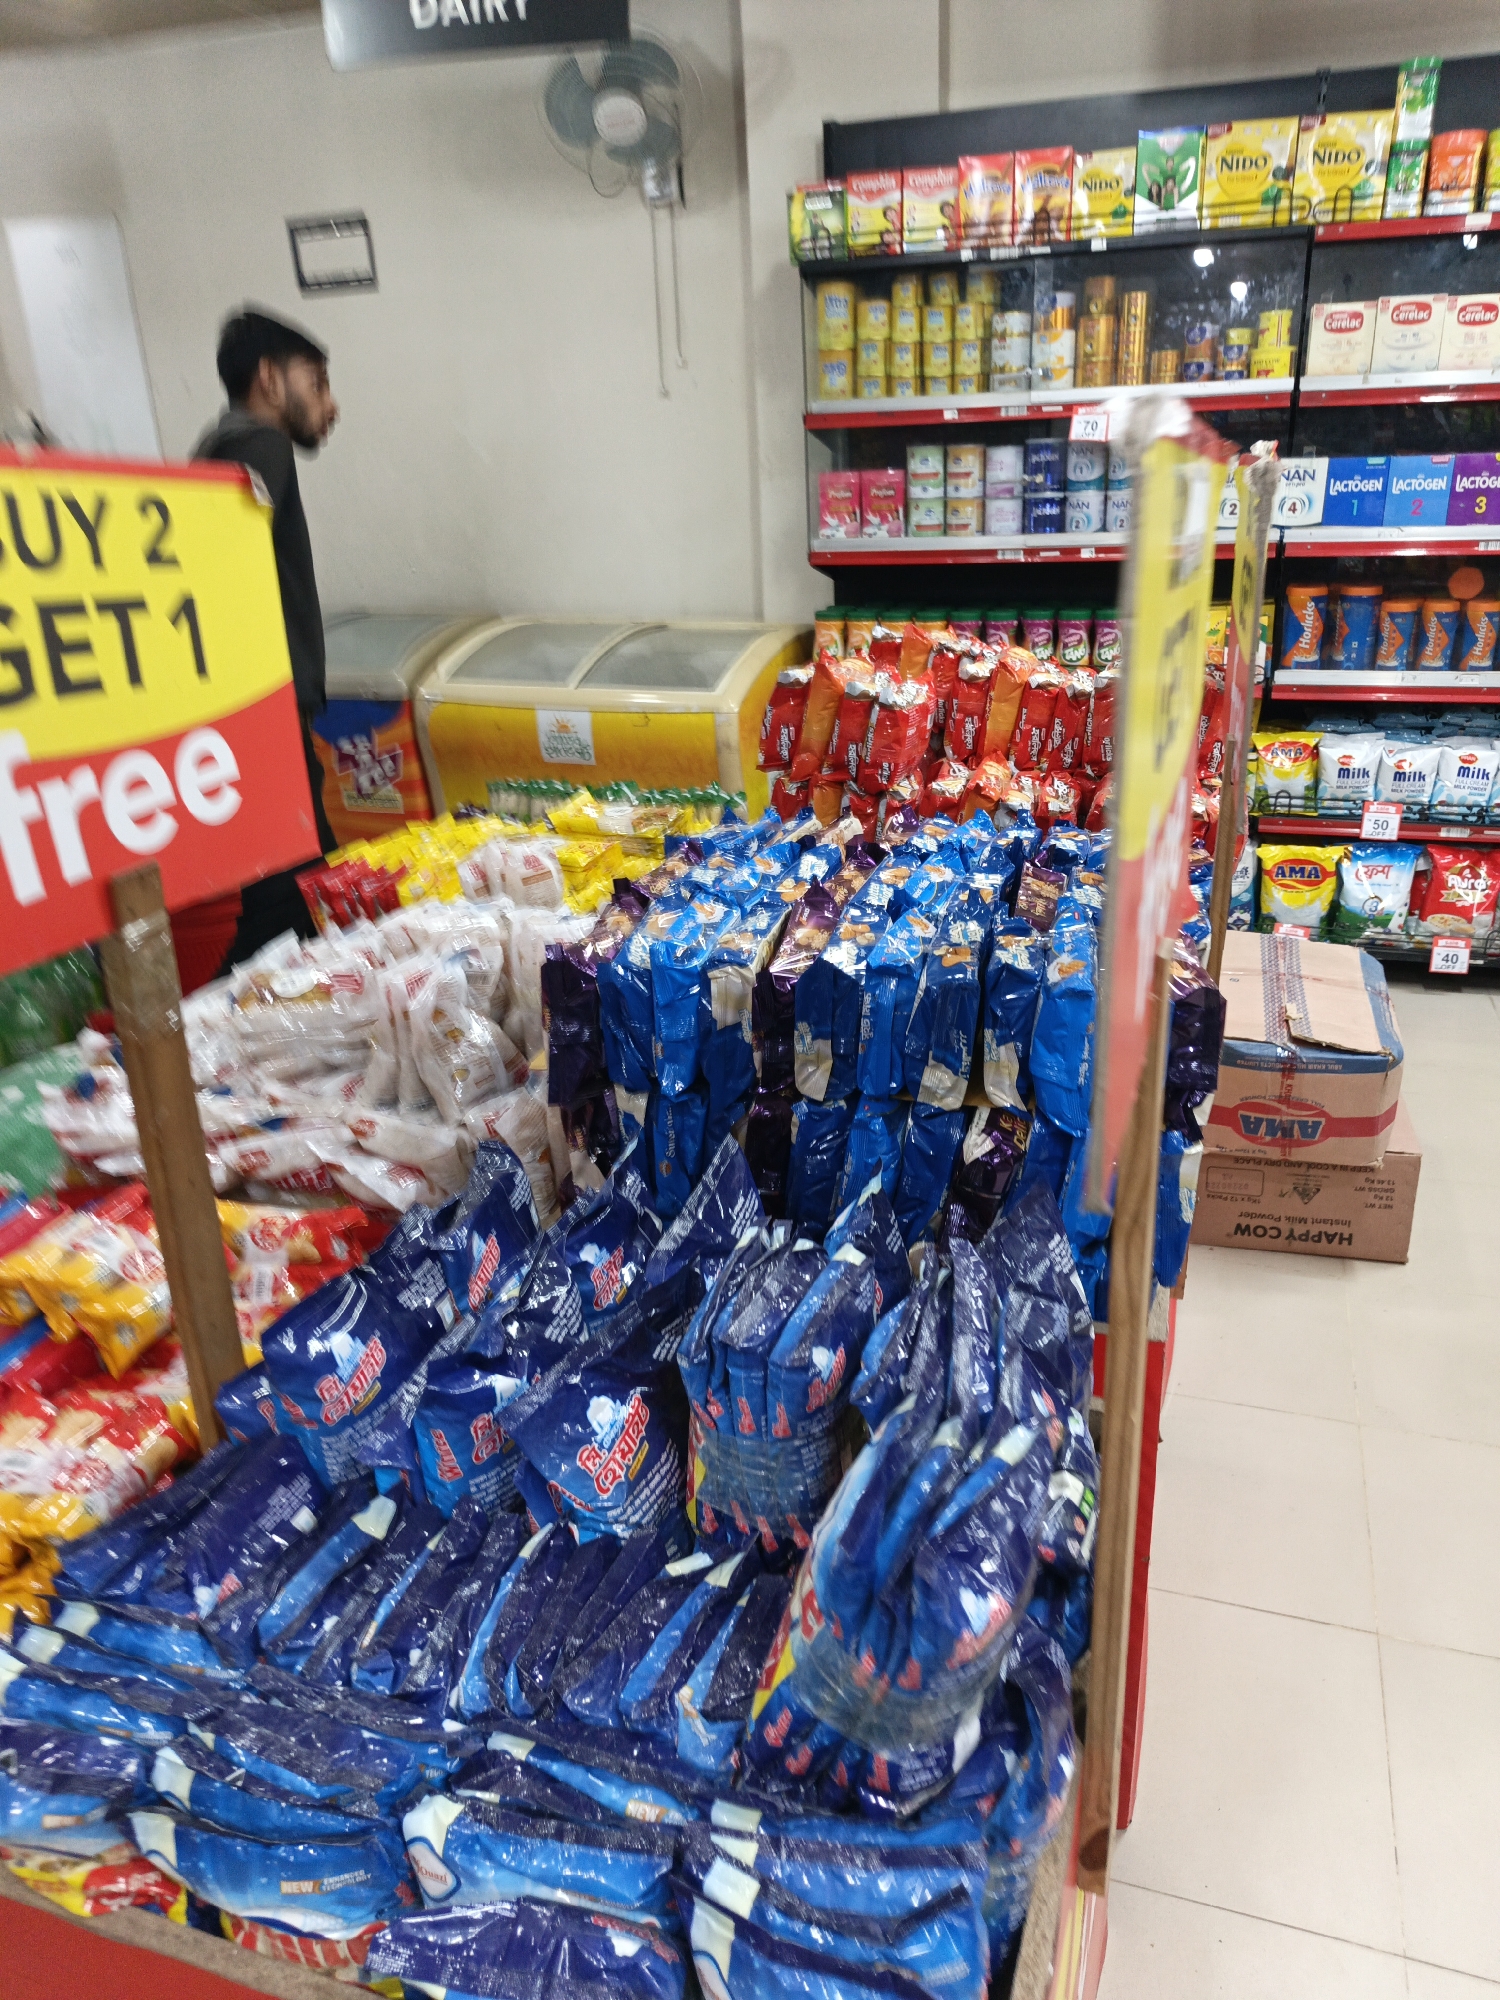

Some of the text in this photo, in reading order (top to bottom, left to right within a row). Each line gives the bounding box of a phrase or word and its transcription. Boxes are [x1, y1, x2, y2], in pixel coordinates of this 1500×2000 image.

[1221, 155, 1268, 173] NIDO
[1312, 148, 1361, 166] NIDO
[1081, 177, 1121, 193] NIDO
[1324, 316, 1362, 330] Cerelac
[1391, 309, 1429, 322] Cerelac
[1458, 309, 1496, 323] Cerelac
[1084, 420, 1098, 432] 70
[1281, 469, 1316, 481] NAN
[1329, 475, 1383, 495] LACTOGEN
[1392, 475, 1448, 494] LACTOGEN
[1456, 474, 1500, 492] LACTOGE
[1069, 501, 1090, 509] NAN
[1229, 503, 1237, 515] 2
[1288, 502, 1298, 514] 4
[1351, 500, 1358, 516] 1
[1411, 498, 1423, 516] 2
[1475, 496, 1487, 514] 3
[1119, 518, 1125, 528] 2
[0, 486, 182, 576] UY 2
[1299, 601, 1315, 649] Horlicks
[166, 588, 211, 685] 1
[1380, 616, 1391, 655] Horlicks
[1424, 616, 1438, 656] Horlicks
[1473, 616, 1488, 656] Horlicks
[1064, 644, 1086, 661] TANG
[1104, 737, 1114, 761] orlicks
[1270, 746, 1303, 757] AMA
[881, 761, 891, 785] orlicks
[1338, 768, 1370, 779] Milk
[1393, 771, 1426, 782] Milk
[1457, 766, 1490, 780] Milk
[0, 726, 243, 907] free
[1373, 820, 1389, 831] 50
[1274, 865, 1321, 880] AMA
[1369, 900, 1379, 913] 3
[1442, 953, 1459, 964] 40
[1327, 1063, 1343, 1071] ABUL
[1238, 1111, 1325, 1141] AMA
[1233, 1157, 1262, 1166] PLACE
[1264, 1159, 1281, 1168] DRY
[1284, 1160, 1303, 1169] AND
[1306, 1163, 1330, 1172] COOL
[1349, 1165, 1375, 1174] KEEP
[1237, 1211, 1351, 1228] Instant Milk Powder
[1233, 1222, 1354, 1247] HAPPY COW
[594, 1394, 650, 1496] হোয়াইট
[283, 1880, 314, 1893] NEW
